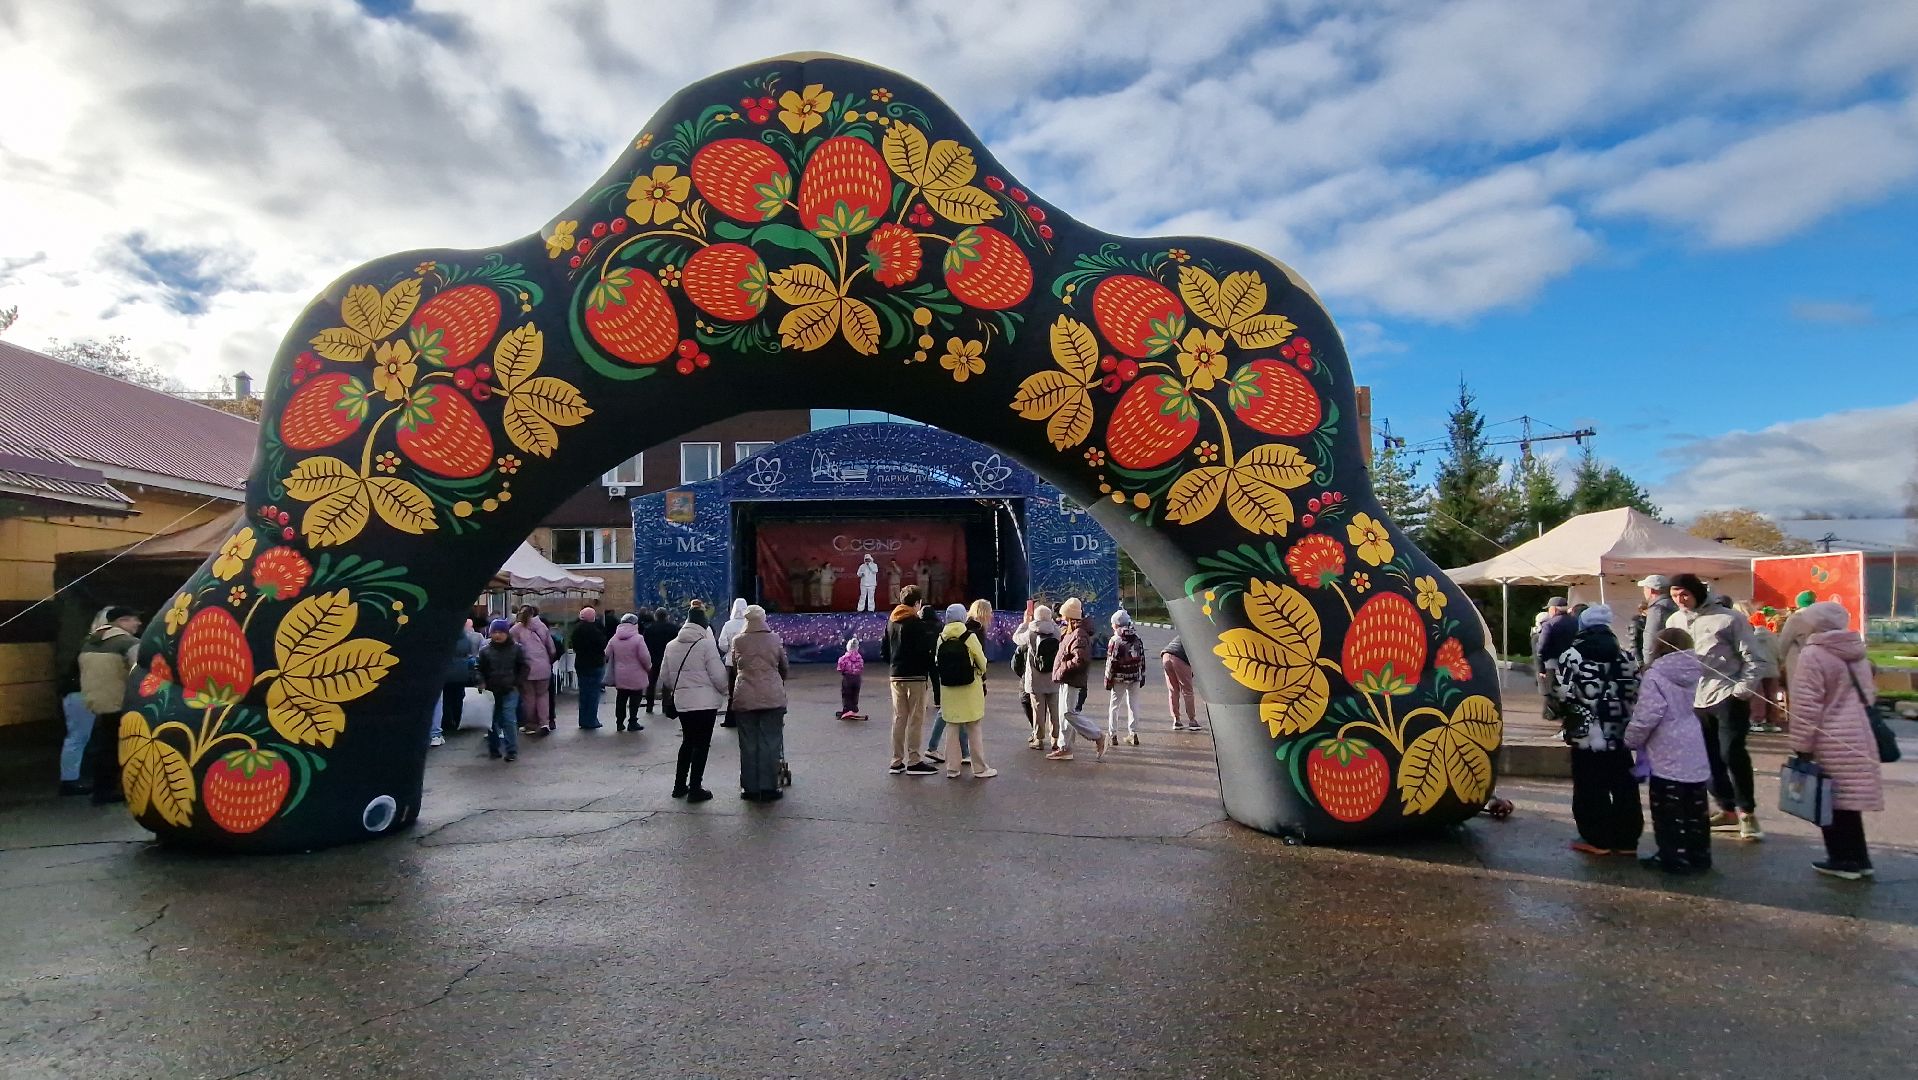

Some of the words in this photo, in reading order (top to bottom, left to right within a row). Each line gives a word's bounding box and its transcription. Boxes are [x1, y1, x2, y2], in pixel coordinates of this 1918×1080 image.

[676, 536, 706, 553] Mc
[1053, 536, 1067, 544] 105
[1072, 534, 1099, 551] Db
[1056, 557, 1097, 566] Dubnium
